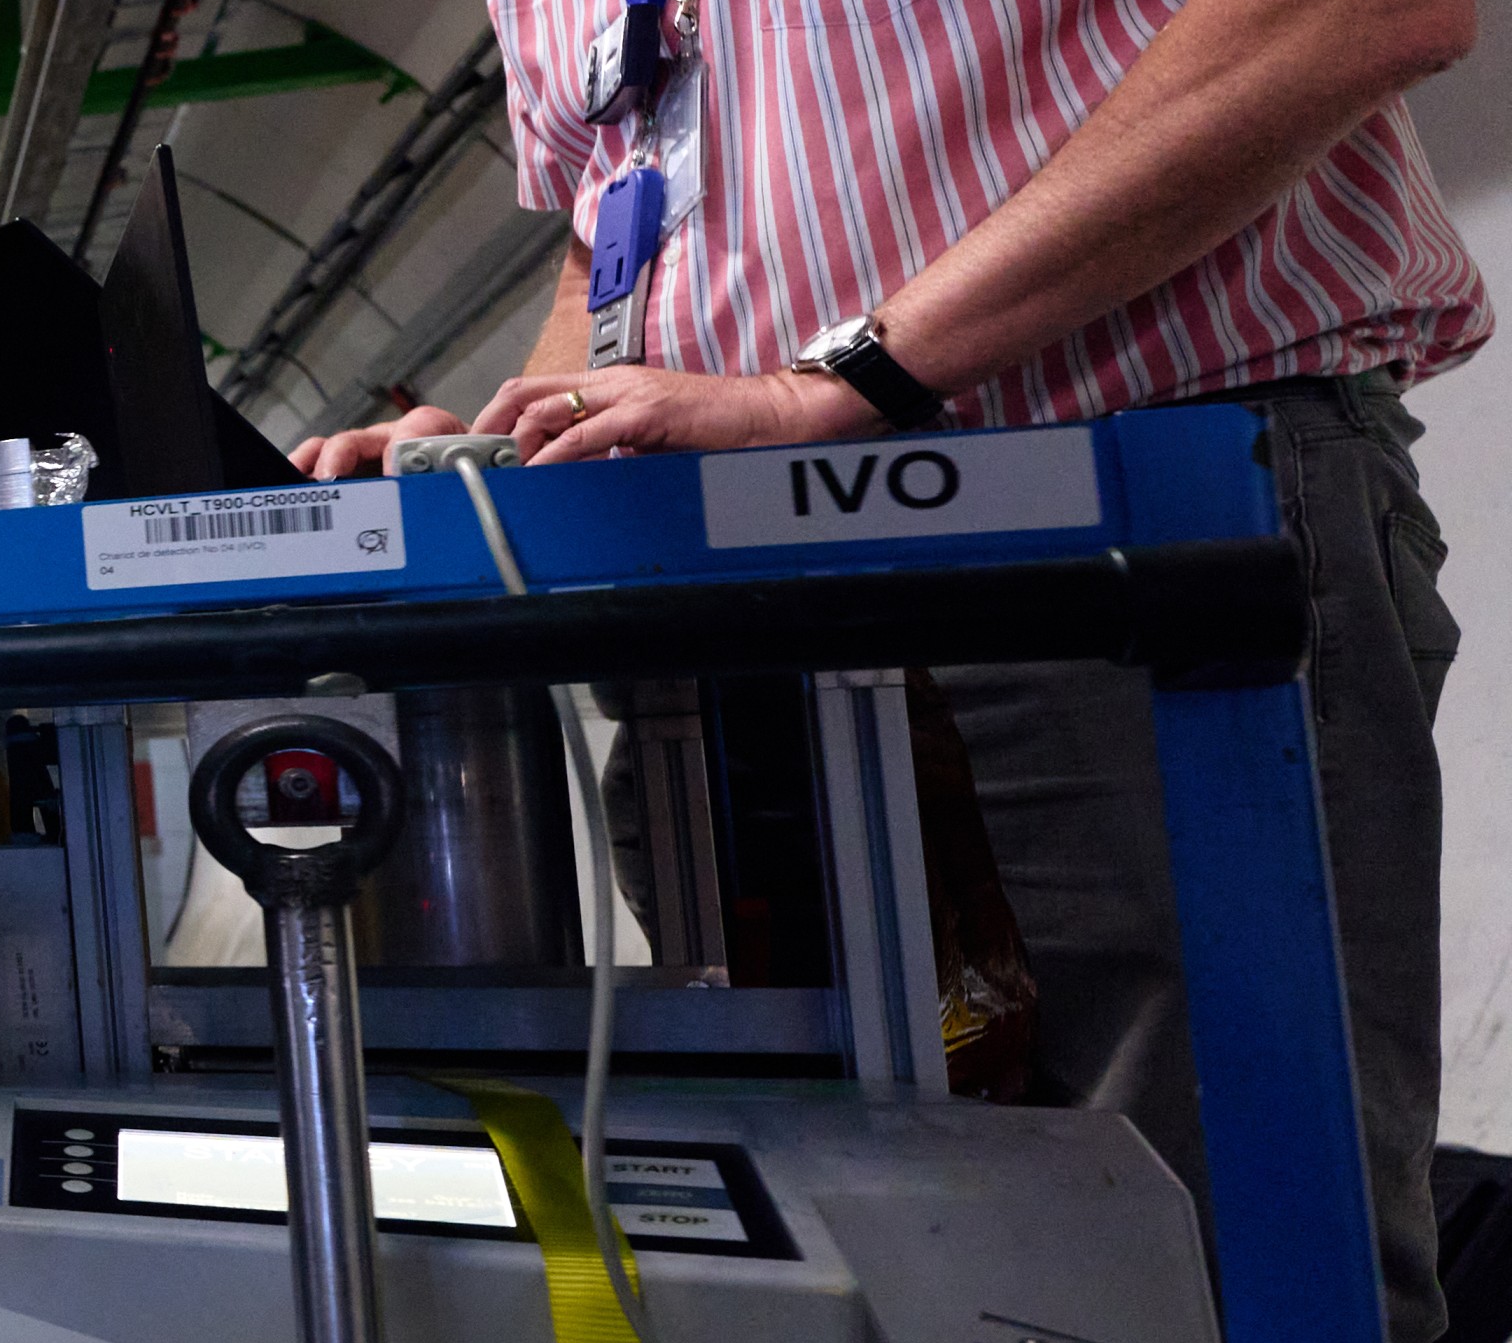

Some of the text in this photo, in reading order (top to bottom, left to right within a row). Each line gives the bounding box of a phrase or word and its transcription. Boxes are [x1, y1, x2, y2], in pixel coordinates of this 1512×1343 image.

[789, 450, 961, 516] IVO
[129, 488, 342, 518] HCVLT_T900-CR000004
[99, 565, 114, 575] 04
[183, 1143, 284, 1164] STA
[613, 1163, 694, 1175] START
[638, 1213, 709, 1224] STOP
